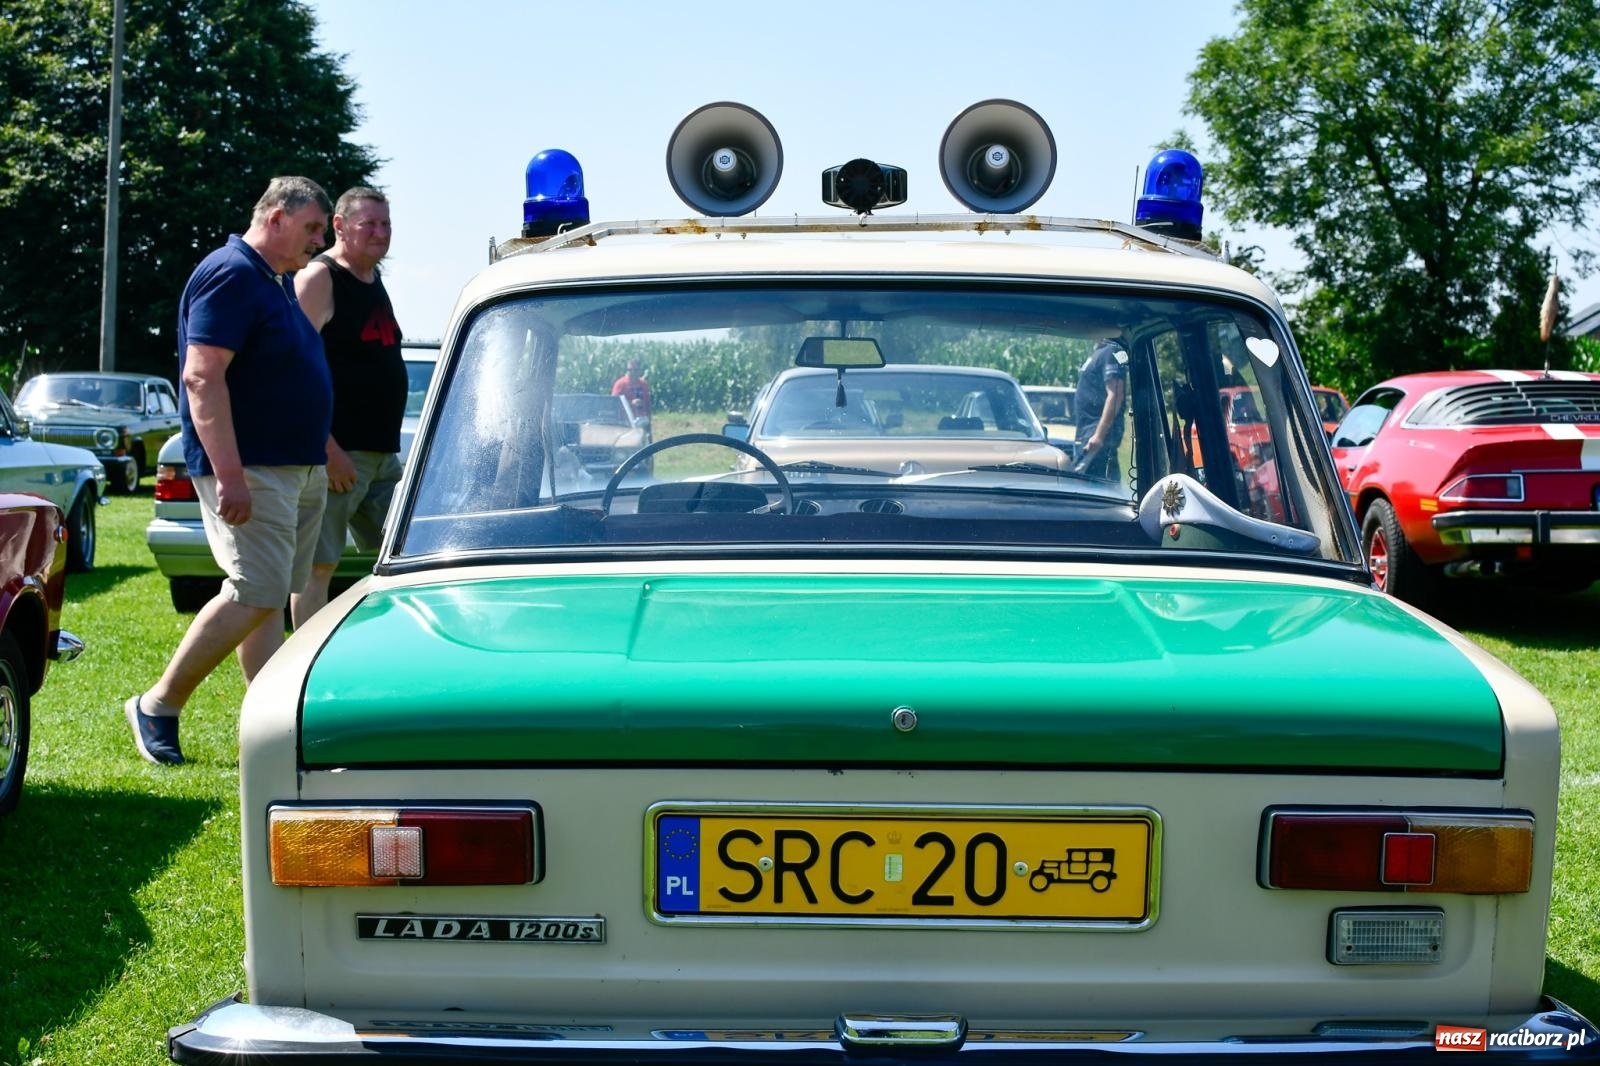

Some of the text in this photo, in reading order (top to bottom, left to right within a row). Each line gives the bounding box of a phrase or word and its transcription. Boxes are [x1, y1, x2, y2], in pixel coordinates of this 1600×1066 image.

[718, 829, 1008, 906] SRC 20
[666, 876, 694, 896] PL
[374, 919, 491, 938] LADA
